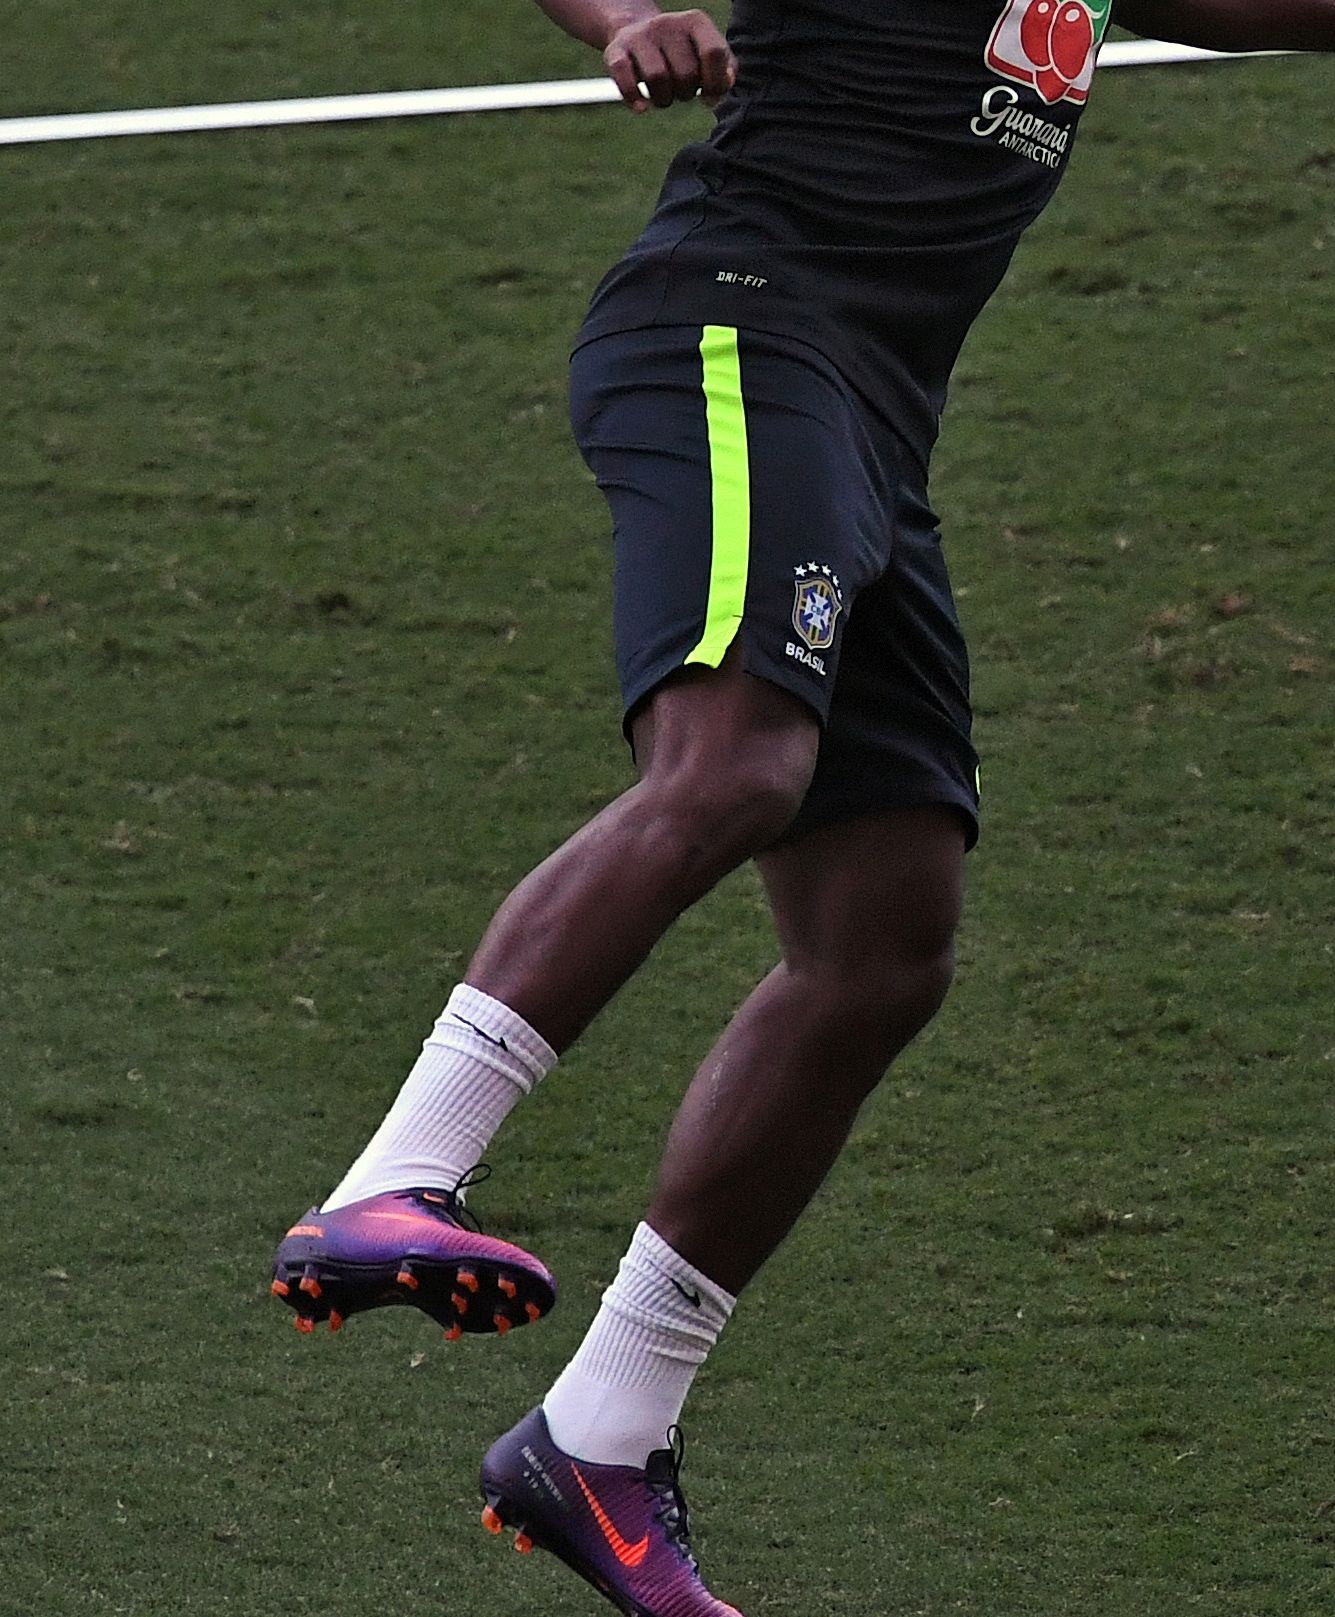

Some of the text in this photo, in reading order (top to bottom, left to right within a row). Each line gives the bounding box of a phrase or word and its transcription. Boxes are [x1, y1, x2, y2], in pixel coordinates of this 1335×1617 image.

[970, 85, 1071, 154] Guaraná
[715, 271, 768, 288] DRI-FIT
[785, 641, 827, 676] BRASIL
